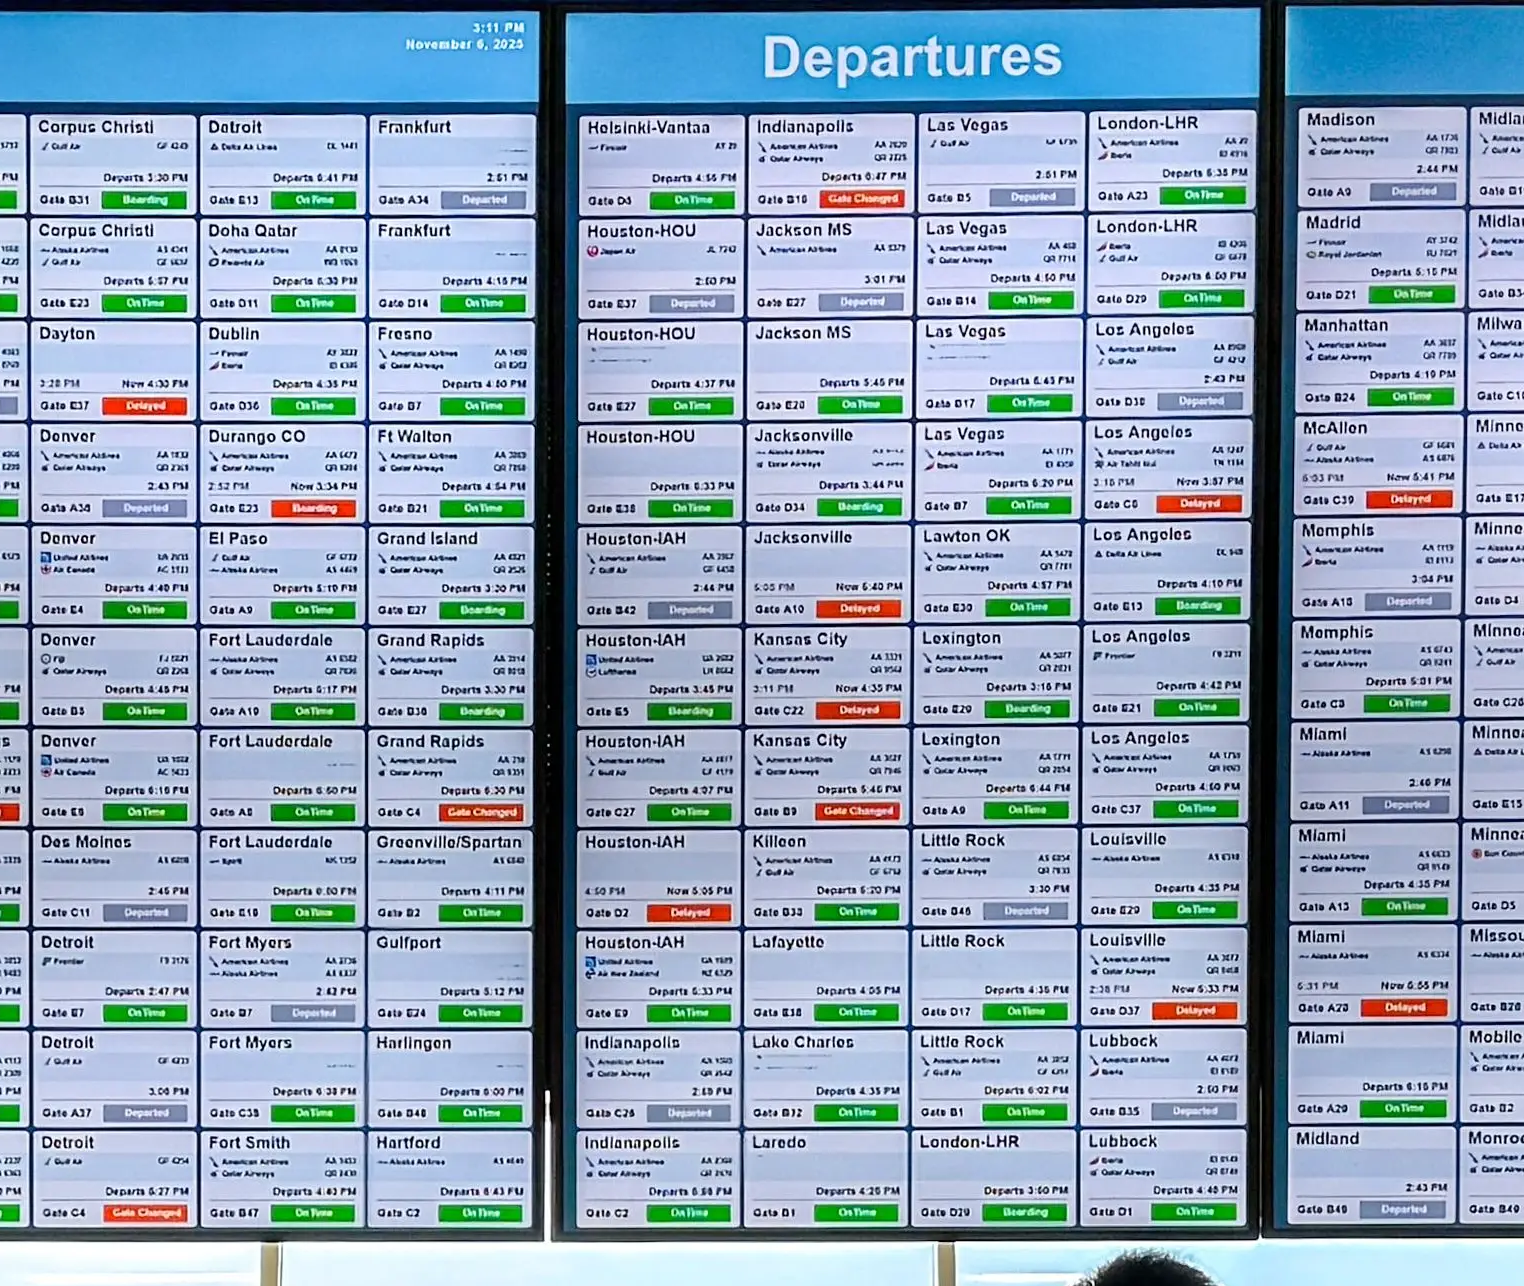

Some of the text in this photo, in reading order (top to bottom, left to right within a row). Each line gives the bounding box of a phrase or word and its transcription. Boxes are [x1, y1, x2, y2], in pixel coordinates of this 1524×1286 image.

[473, 23, 524, 33] 3:11 PM
[406, 39, 472, 50] November
[494, 39, 524, 49] 2025
[765, 36, 1061, 88] Departures
[1308, 113, 1374, 125] Madison
[39, 120, 153, 136] Corpus Christi
[1441, 165, 1458, 173] PM
[379, 224, 450, 237] Frankfurt
[588, 224, 695, 238] Houston-HOU
[756, 223, 851, 236] Jackson MS
[927, 221, 1006, 237] Las Vegas
[1305, 319, 1388, 331] Manhattan
[40, 327, 95, 342] Dayton
[209, 327, 259, 340] Dublin
[210, 430, 305, 445] Durango CO
[378, 430, 451, 443] Ft Walton
[755, 428, 853, 442] Jacksonville
[1095, 426, 1192, 441] Los Angeles
[924, 529, 1010, 542] Lawton OK
[1302, 524, 1374, 539] Memphis
[587, 532, 685, 545] Houston-IAH
[755, 633, 847, 647] Kansas City
[885, 684, 902, 693] PM
[754, 706, 780, 715] Gate
[839, 705, 880, 716] Delayed
[377, 735, 484, 750] Grand Rapids
[1091, 832, 1166, 845] Louisville
[1299, 829, 1345, 842] Miami
[42, 936, 93, 948] Detroit
[921, 934, 1004, 947] Little Rock
[377, 1136, 440, 1149] Hartford
[753, 1136, 806, 1148] Laredo
[921, 1135, 1019, 1148] London-LHR
[1090, 1134, 1157, 1147] Lubbock
[1297, 1132, 1359, 1144] Midland
